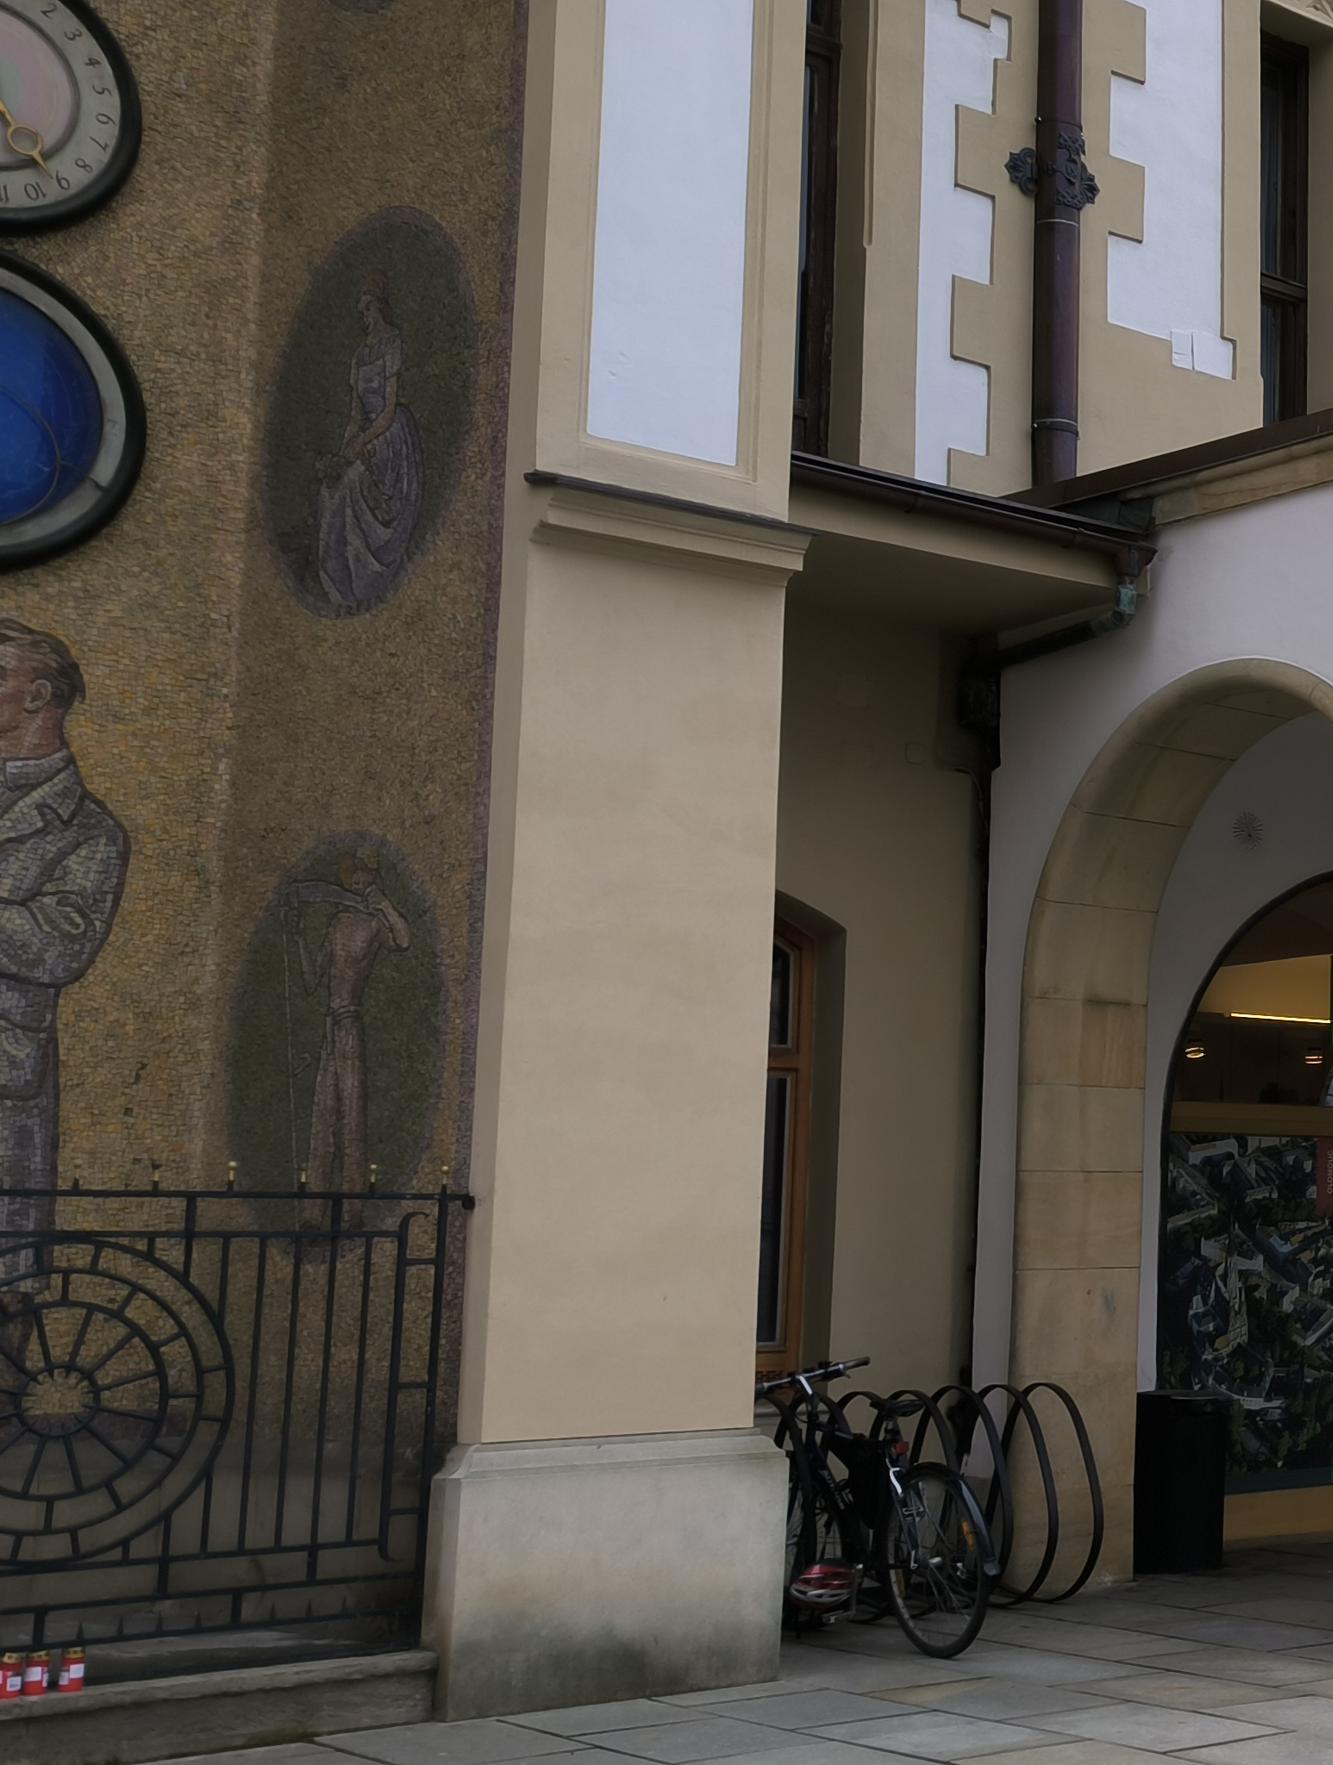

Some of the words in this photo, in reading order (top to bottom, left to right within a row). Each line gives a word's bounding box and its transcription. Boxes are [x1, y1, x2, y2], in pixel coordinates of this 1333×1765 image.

[41, 2, 57, 19] 2
[63, 28, 83, 41] 3
[84, 57, 102, 68] 4
[92, 84, 112, 97] 5
[89, 136, 109, 152] 7
[74, 157, 94, 174] 8
[1326, 1150, 1333, 1194] OLOMOUC
